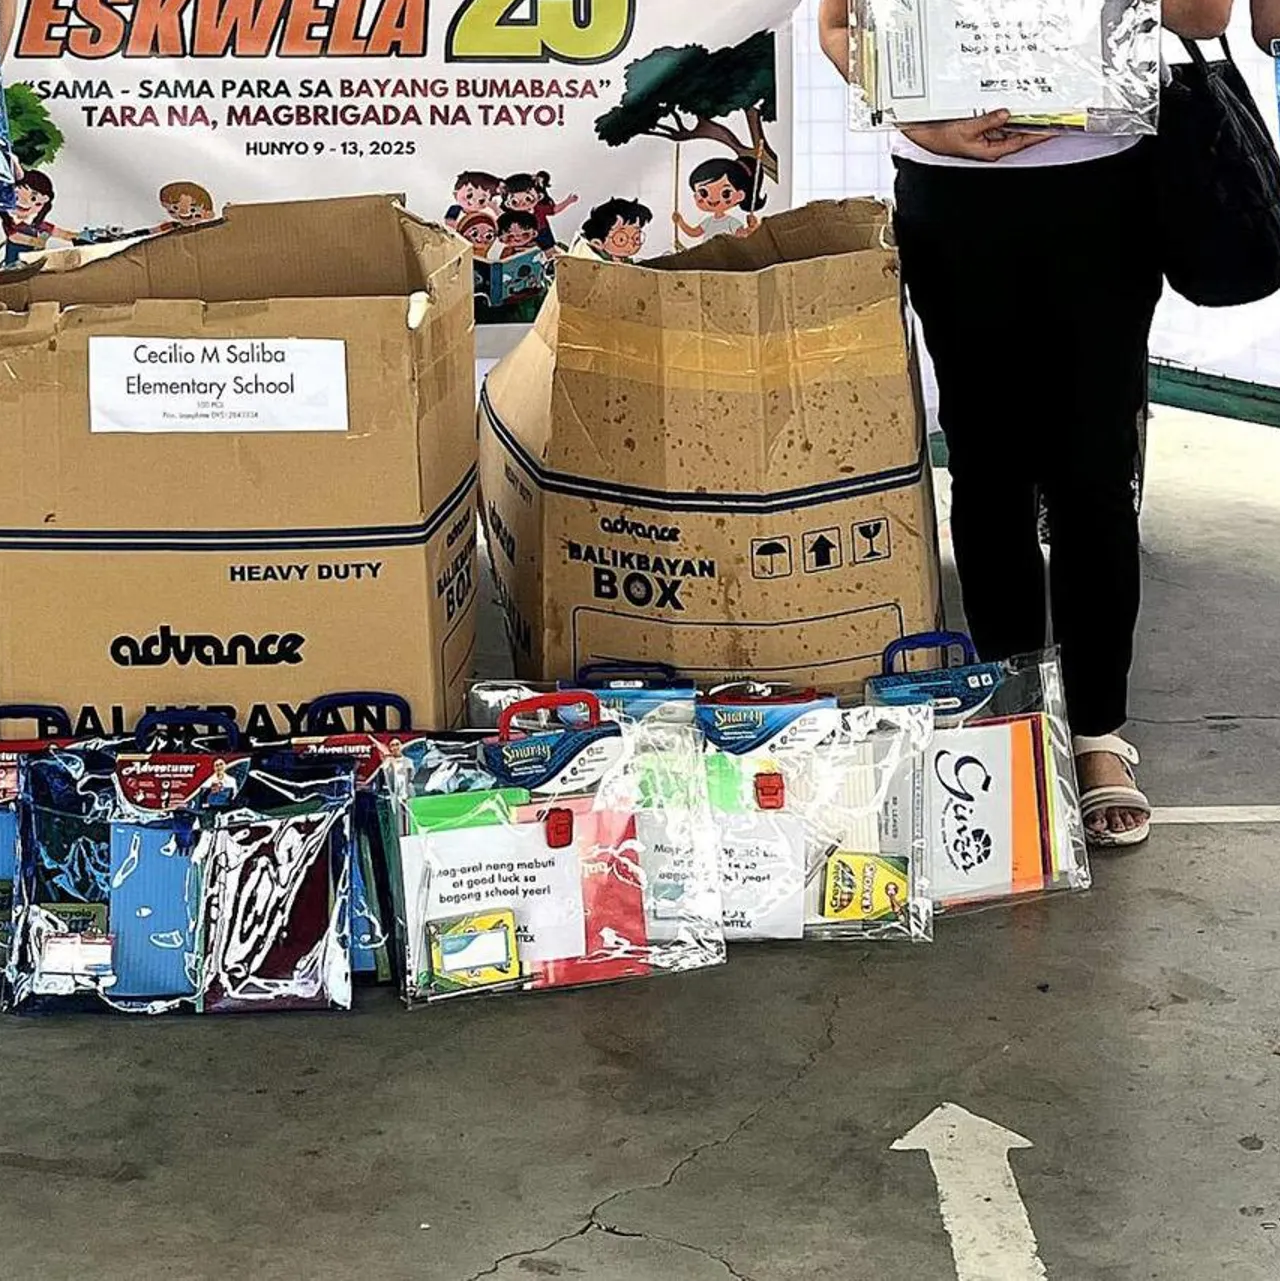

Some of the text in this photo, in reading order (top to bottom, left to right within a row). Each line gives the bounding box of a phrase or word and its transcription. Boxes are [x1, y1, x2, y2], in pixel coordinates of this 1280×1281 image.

[138, 79, 215, 99] SAMA
[222, 79, 292, 99] PARA
[299, 79, 334, 99] SA
[339, 78, 449, 99] BAYANG
[81, 104, 566, 131] TARA NA, MAGBRIGADA NA TAYO!
[246, 141, 308, 156] HUNYO
[313, 141, 325, 156] 9
[341, 141, 364, 158] 13,
[370, 141, 416, 156] 2025
[134, 343, 286, 364] Cecilio M Saliba
[126, 373, 295, 400] Elementary School
[600, 516, 681, 543] advance
[567, 539, 716, 579] BALIKBAYAN
[229, 561, 383, 583] HEAVY DUTY
[593, 566, 685, 611] BOX
[109, 626, 306, 667] advance
[39, 703, 388, 738] BALAYAN
[502, 744, 551, 764] Smarty
[121, 761, 196, 776] Adventurer
[486, 863, 514, 872] nang
[517, 857, 556, 869] mabuti
[467, 875, 495, 889] good
[497, 873, 520, 883] luck
[523, 875, 536, 883] sa
[438, 890, 481, 904] bagong
[485, 886, 519, 898] school
